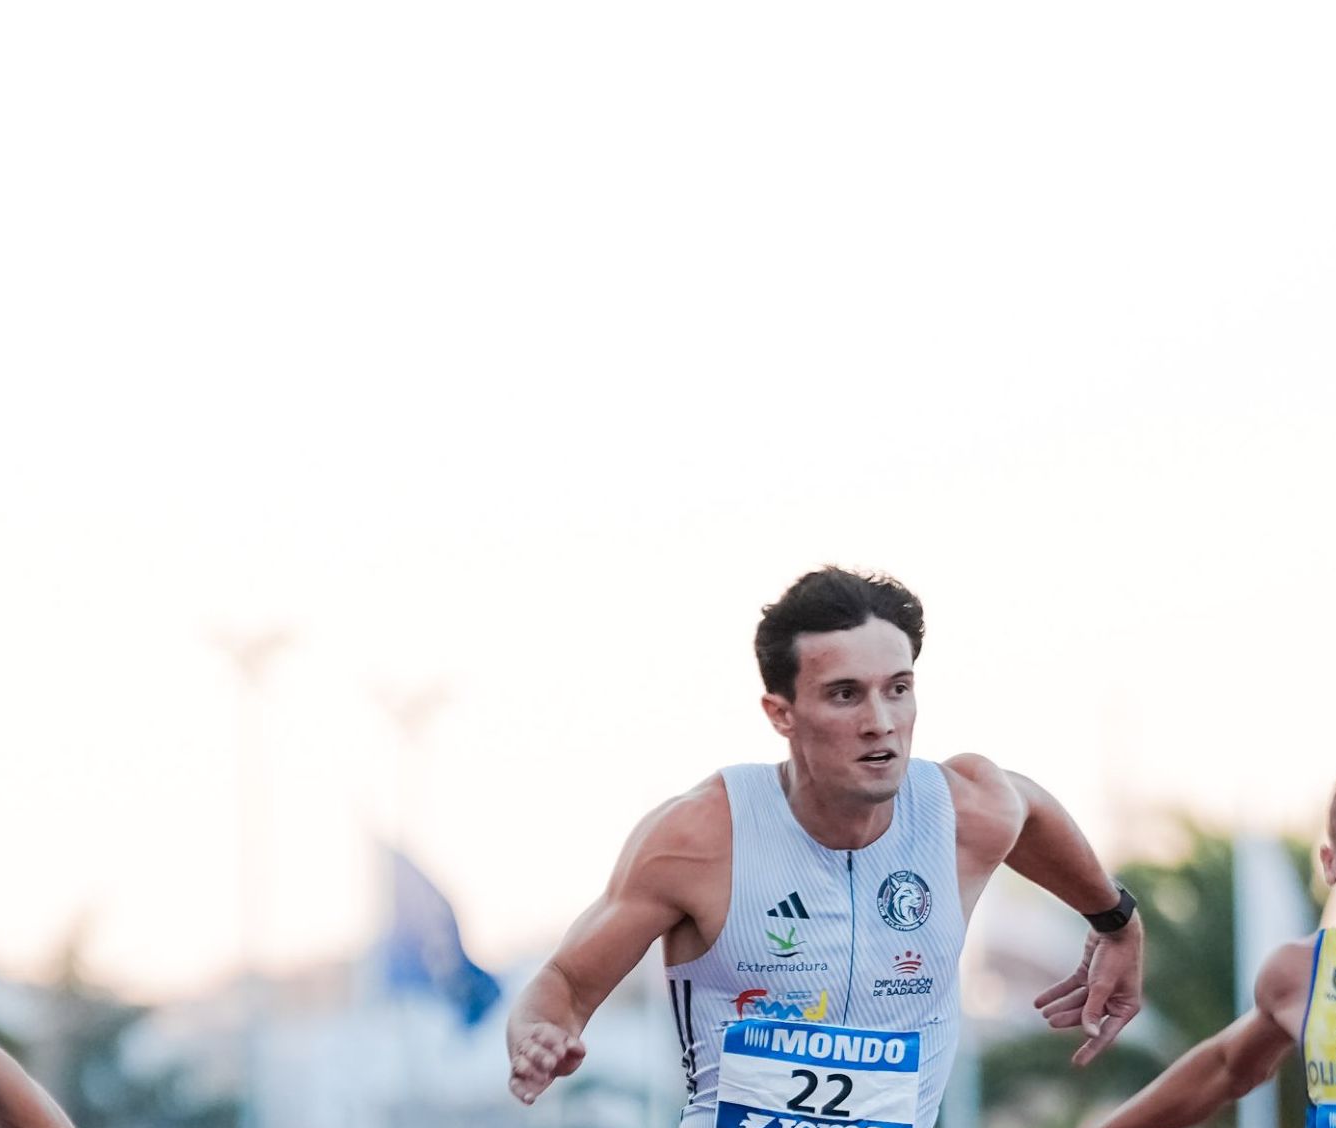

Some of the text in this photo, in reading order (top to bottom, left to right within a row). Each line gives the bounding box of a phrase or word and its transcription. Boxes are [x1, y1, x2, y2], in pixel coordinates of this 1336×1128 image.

[737, 961, 828, 973] Extremadura
[874, 975, 933, 988] DIPUTACIÓN
[873, 985, 931, 997] DE BADAJOZ
[771, 1028, 905, 1064] MONDO
[786, 1069, 853, 1117] 22
